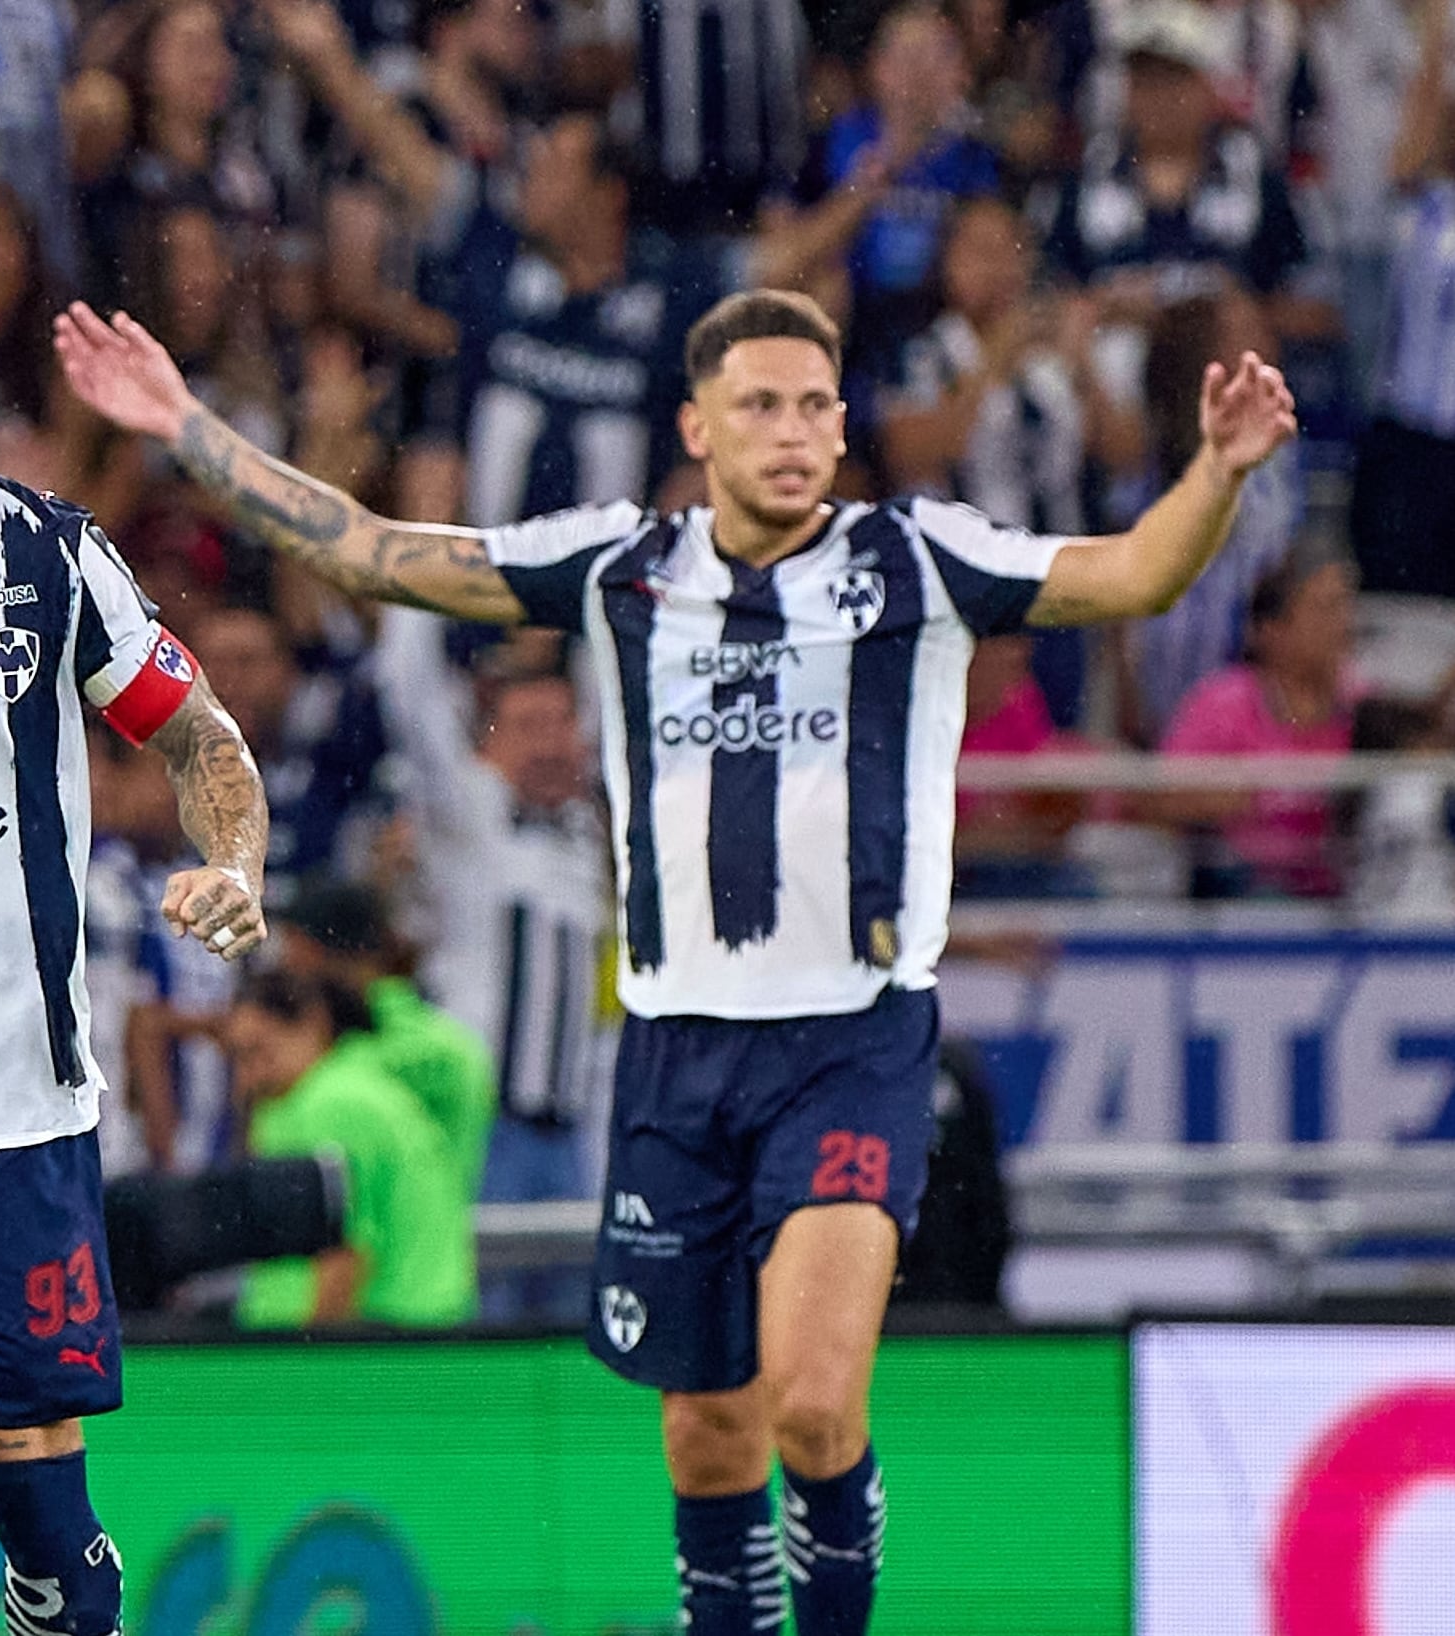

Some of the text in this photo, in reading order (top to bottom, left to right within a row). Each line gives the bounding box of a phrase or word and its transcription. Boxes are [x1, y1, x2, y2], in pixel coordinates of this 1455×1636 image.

[690, 644, 803, 679] BBVA
[658, 696, 838, 746] codere
[811, 1130, 890, 1200] 29
[25, 1242, 102, 1338] 93
